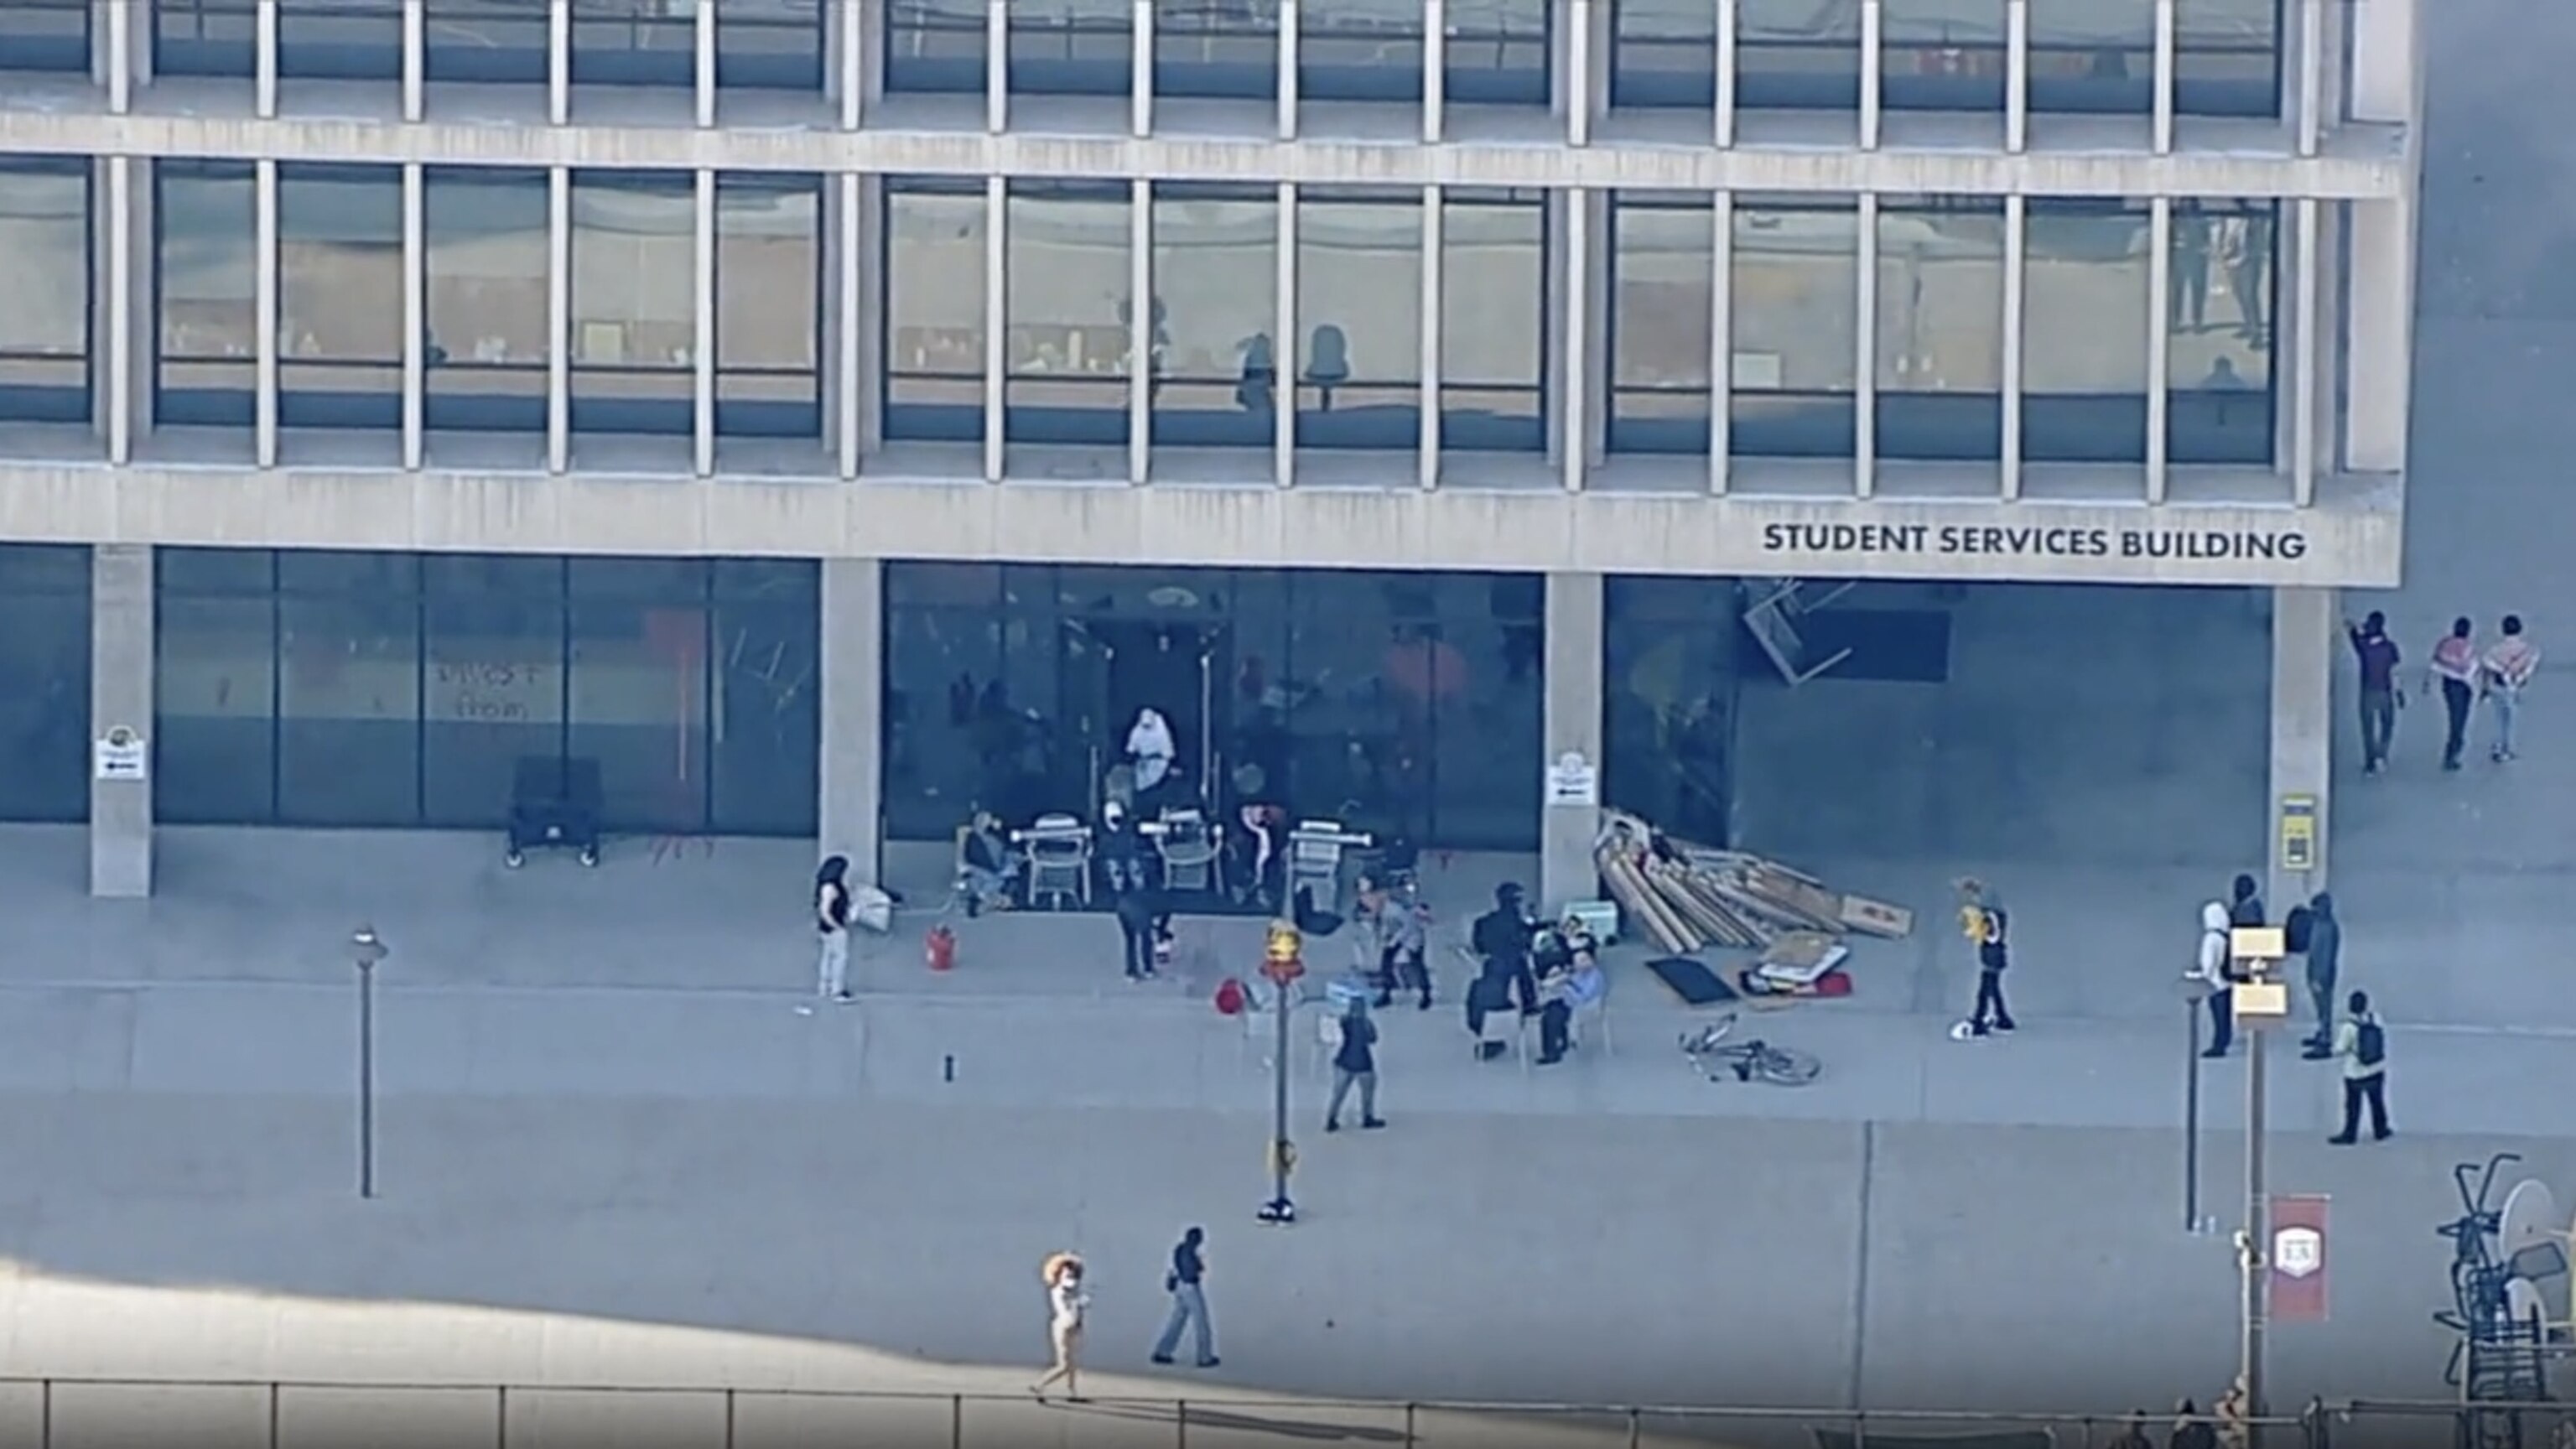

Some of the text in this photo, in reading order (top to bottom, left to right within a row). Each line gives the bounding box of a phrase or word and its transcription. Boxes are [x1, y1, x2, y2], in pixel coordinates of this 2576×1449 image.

[1763, 523, 2306, 558] STUDENT SERVICES BUILDING
